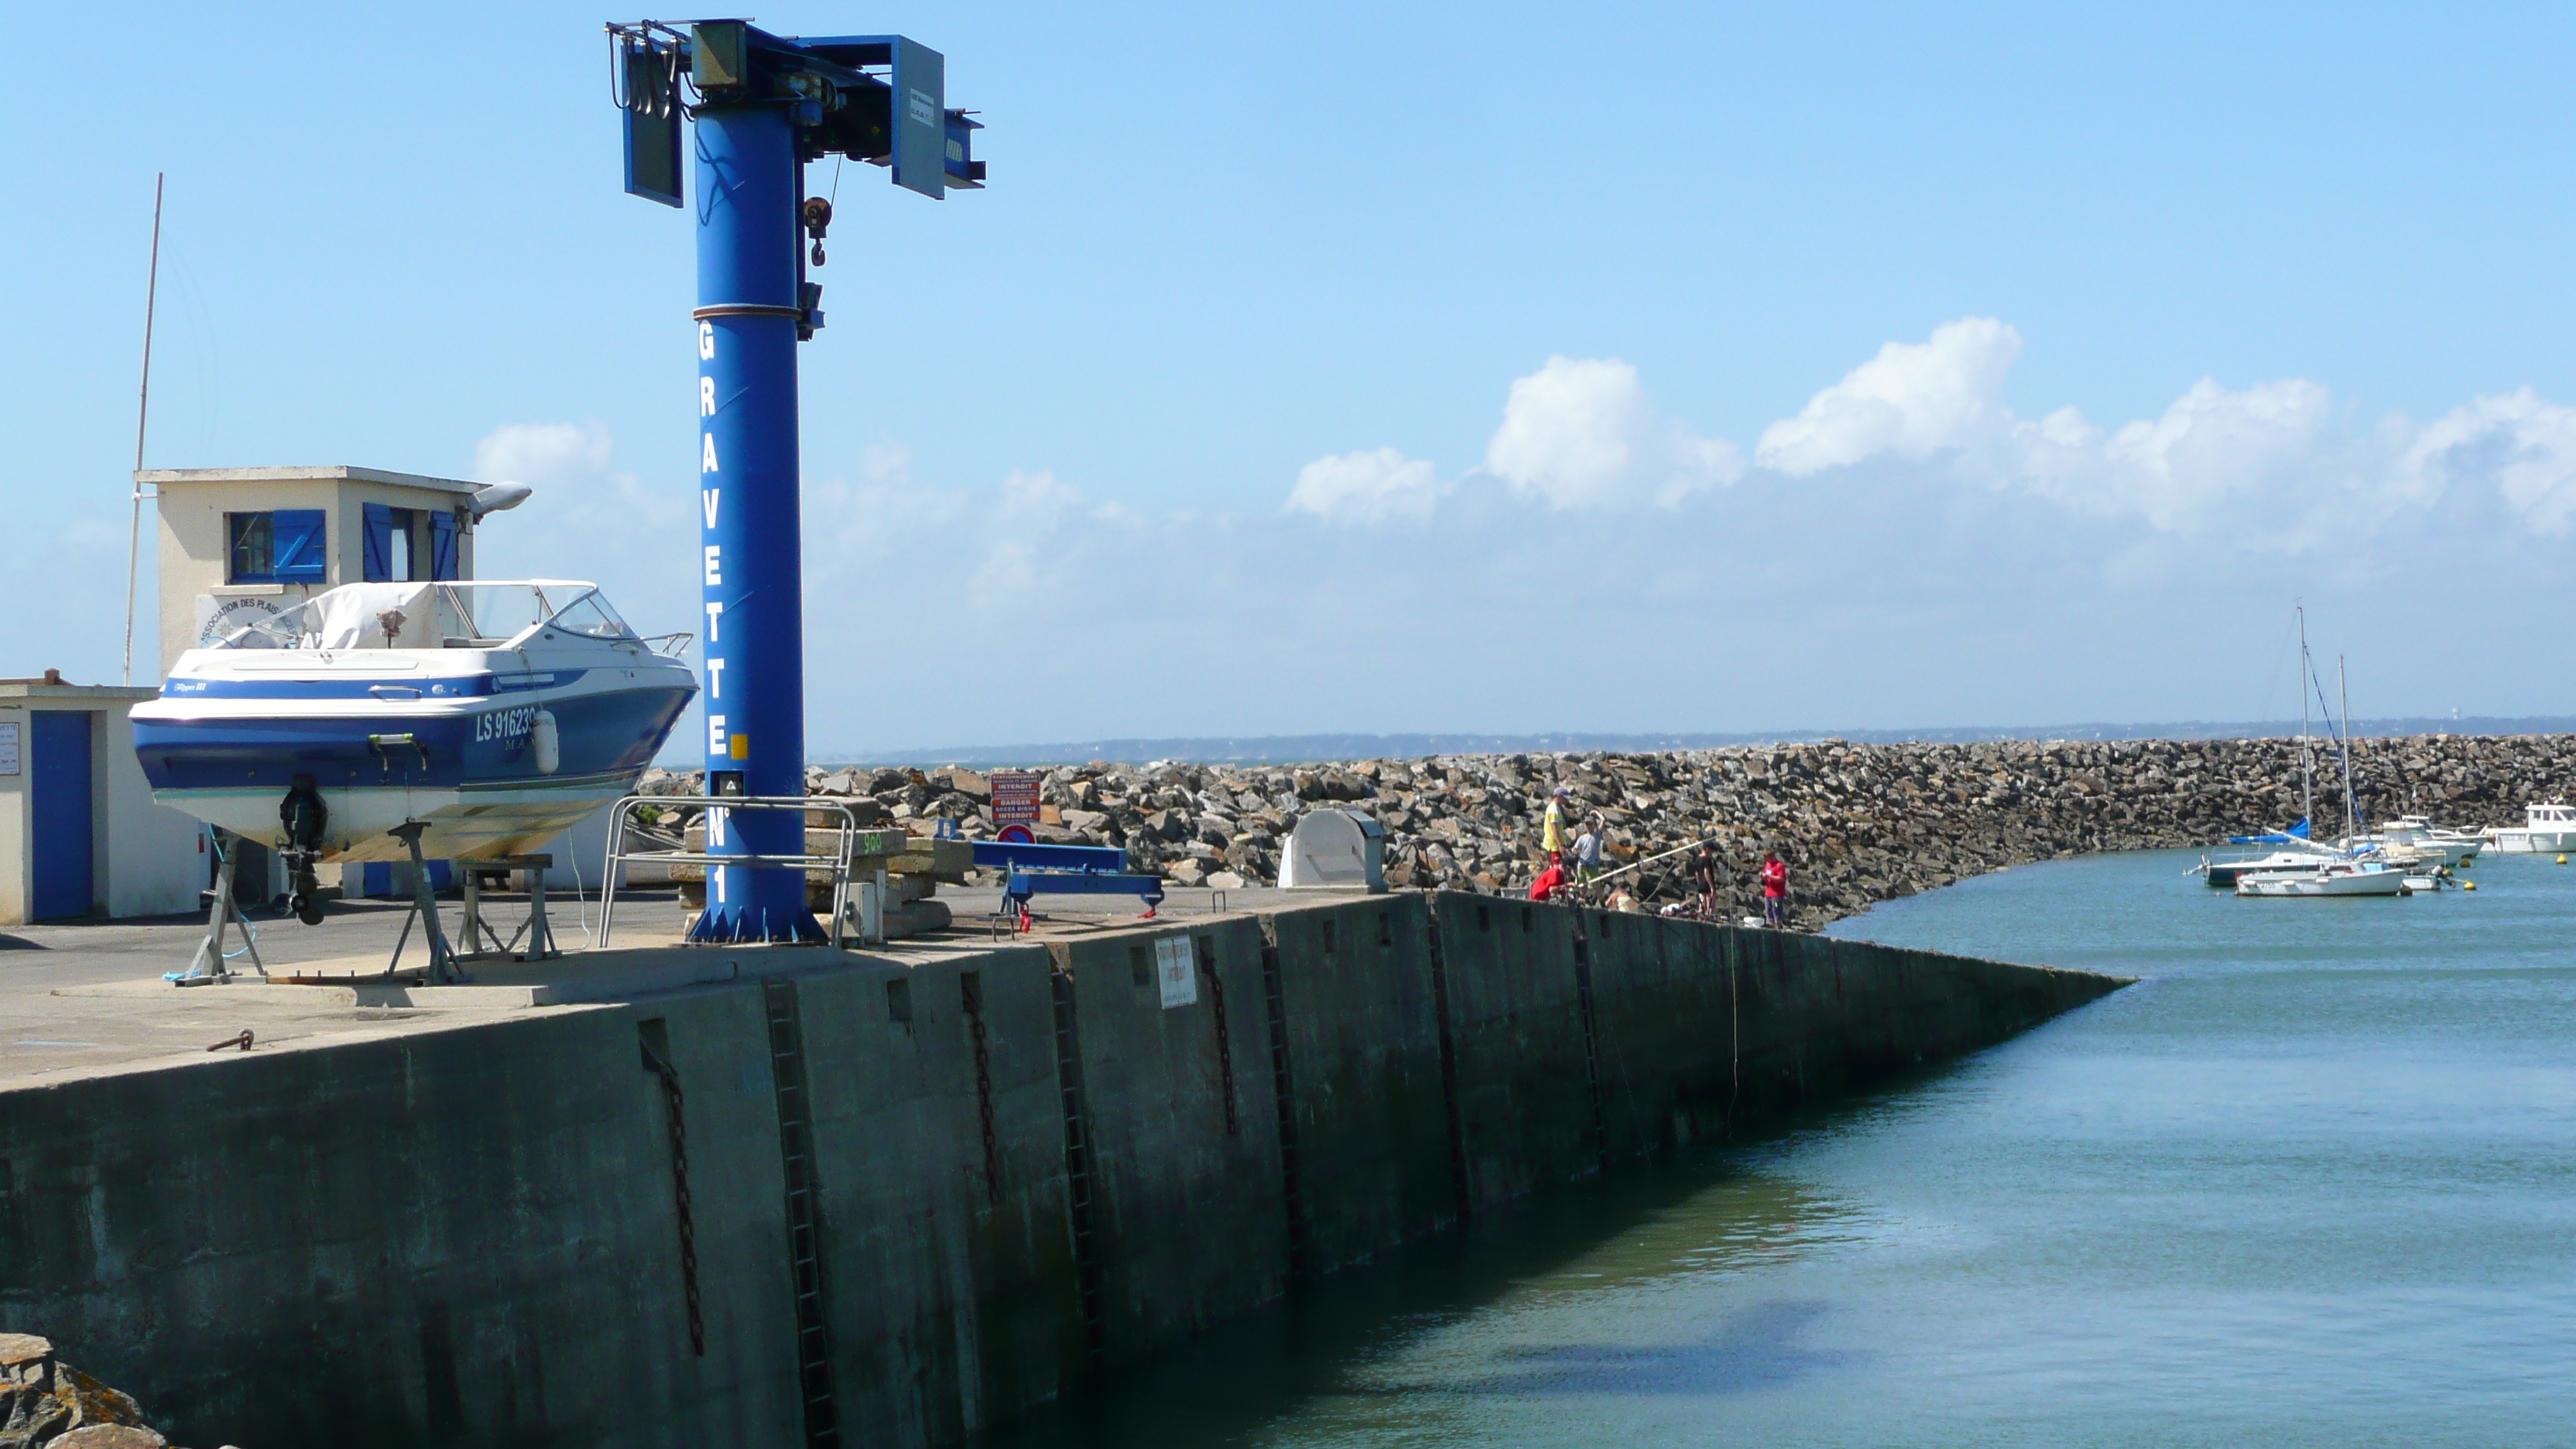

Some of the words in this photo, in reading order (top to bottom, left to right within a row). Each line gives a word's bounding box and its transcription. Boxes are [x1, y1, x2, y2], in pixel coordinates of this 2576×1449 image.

[201, 600, 239, 642] ASSOCIATION
[241, 598, 255, 608] DES
[699, 320, 727, 755] GRAVETTE
[714, 865, 726, 903] 1
[476, 713, 492, 742] LS
[865, 833, 882, 855] 900
